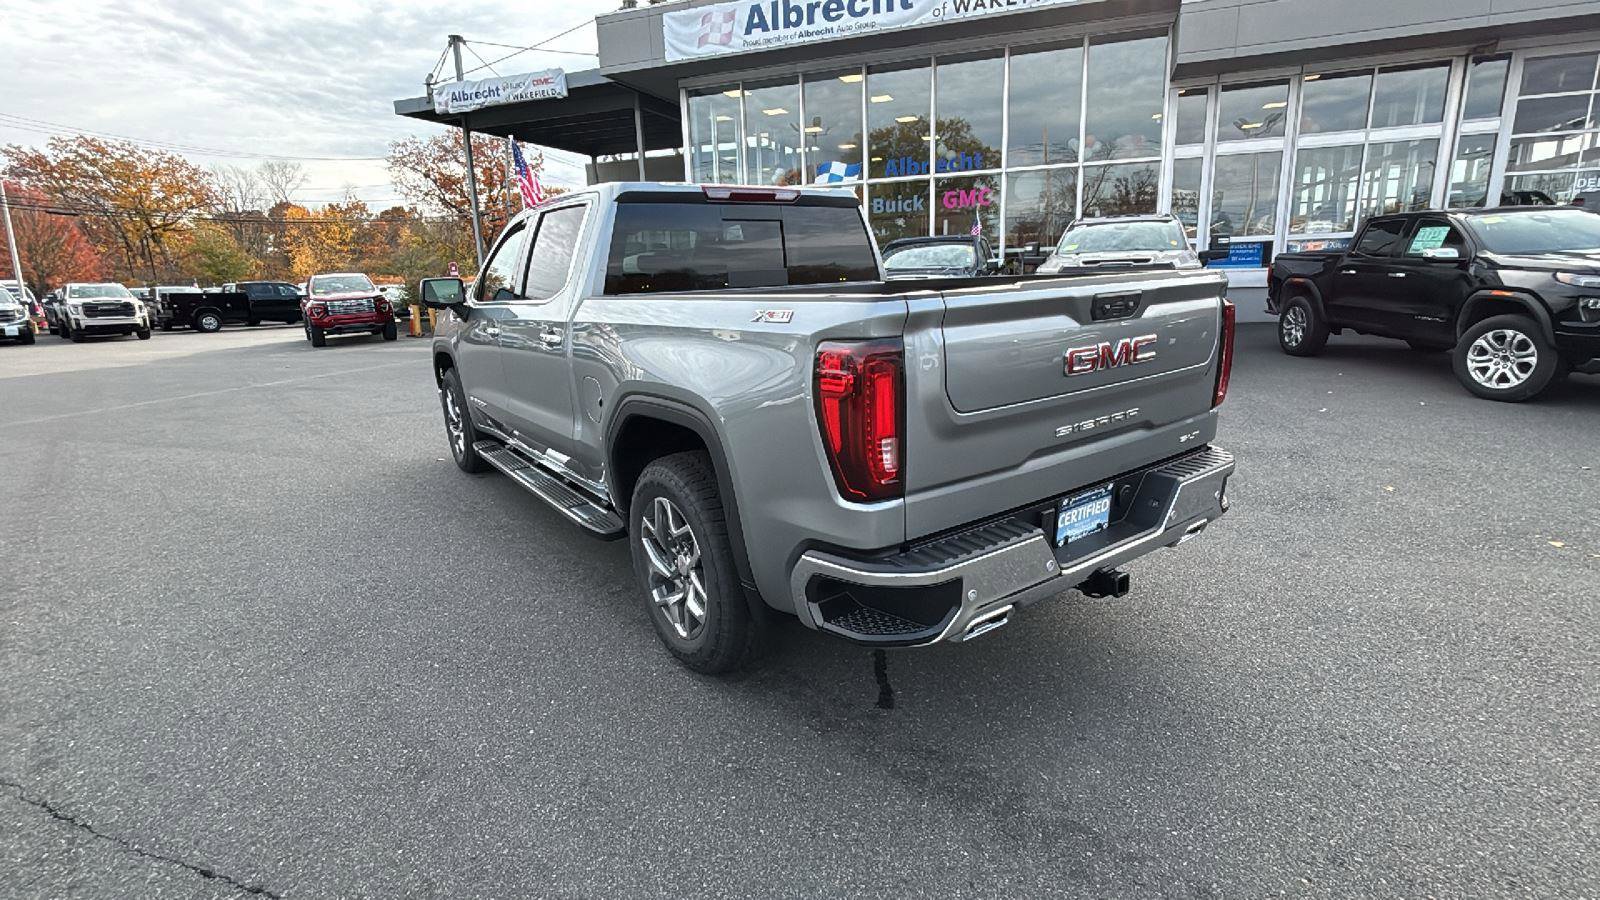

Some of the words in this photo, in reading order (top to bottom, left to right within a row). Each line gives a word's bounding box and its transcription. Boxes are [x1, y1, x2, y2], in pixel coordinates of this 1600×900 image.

[933, 3, 947, 17] of
[742, 38, 761, 47] Proud
[762, 35, 789, 45] member
[790, 32, 798, 41] of
[798, 26, 834, 38] Albrecht
[837, 24, 852, 33] Auto
[855, 21, 876, 31] Group
[451, 86, 501, 103] Albrecht
[532, 77, 555, 87] GMC
[513, 88, 557, 101] WAKEFIELD
[885, 152, 983, 177] Albrecht
[1577, 177, 1600, 188] DE
[872, 194, 924, 214] Buick
[943, 187, 992, 209] GMC
[1063, 334, 1157, 377] GMC
[1055, 408, 1139, 438] SIERRA
[1058, 499, 1110, 528] CERTIFIED
